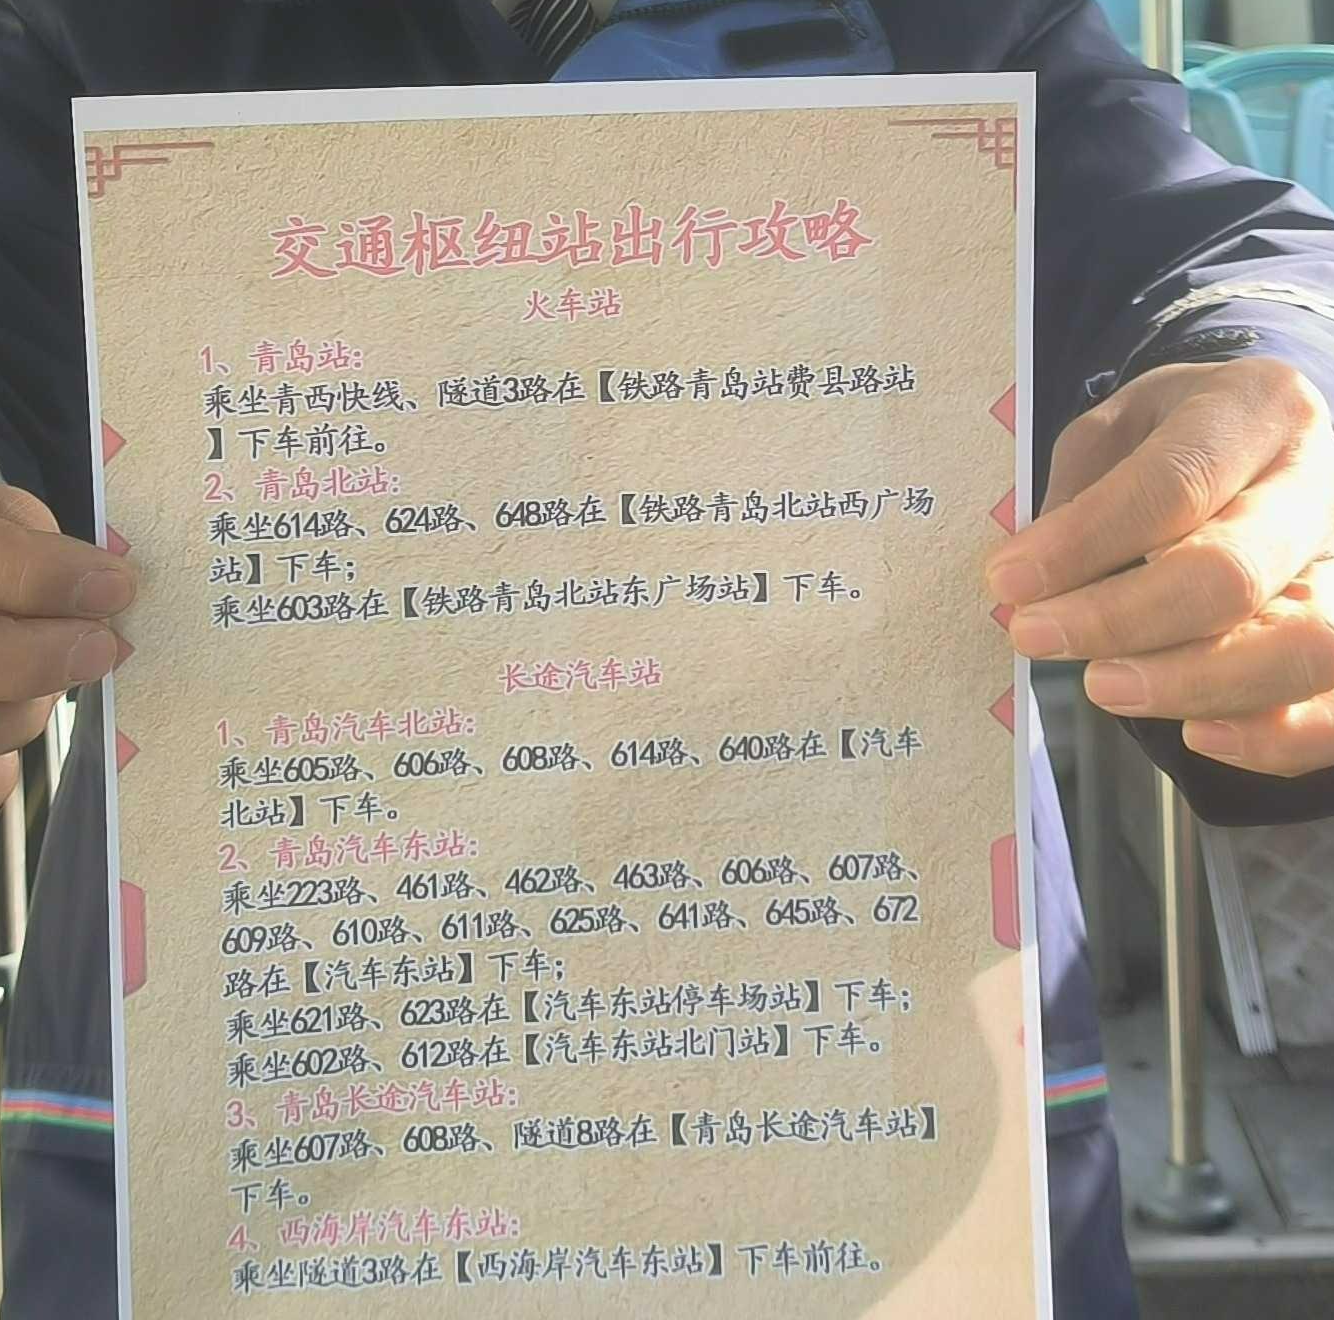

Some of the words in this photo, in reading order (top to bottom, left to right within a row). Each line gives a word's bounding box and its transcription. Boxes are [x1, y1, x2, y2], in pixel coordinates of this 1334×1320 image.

[271, 200, 870, 278] 交通枢纽站出行攻略
[523, 289, 623, 321] 火车站
[206, 424, 387, 459] 】下车前往。
[499, 658, 662, 691] 长途汽车站
[220, 792, 399, 827] 北站】下车。
[230, 1179, 311, 1212] 下车。
